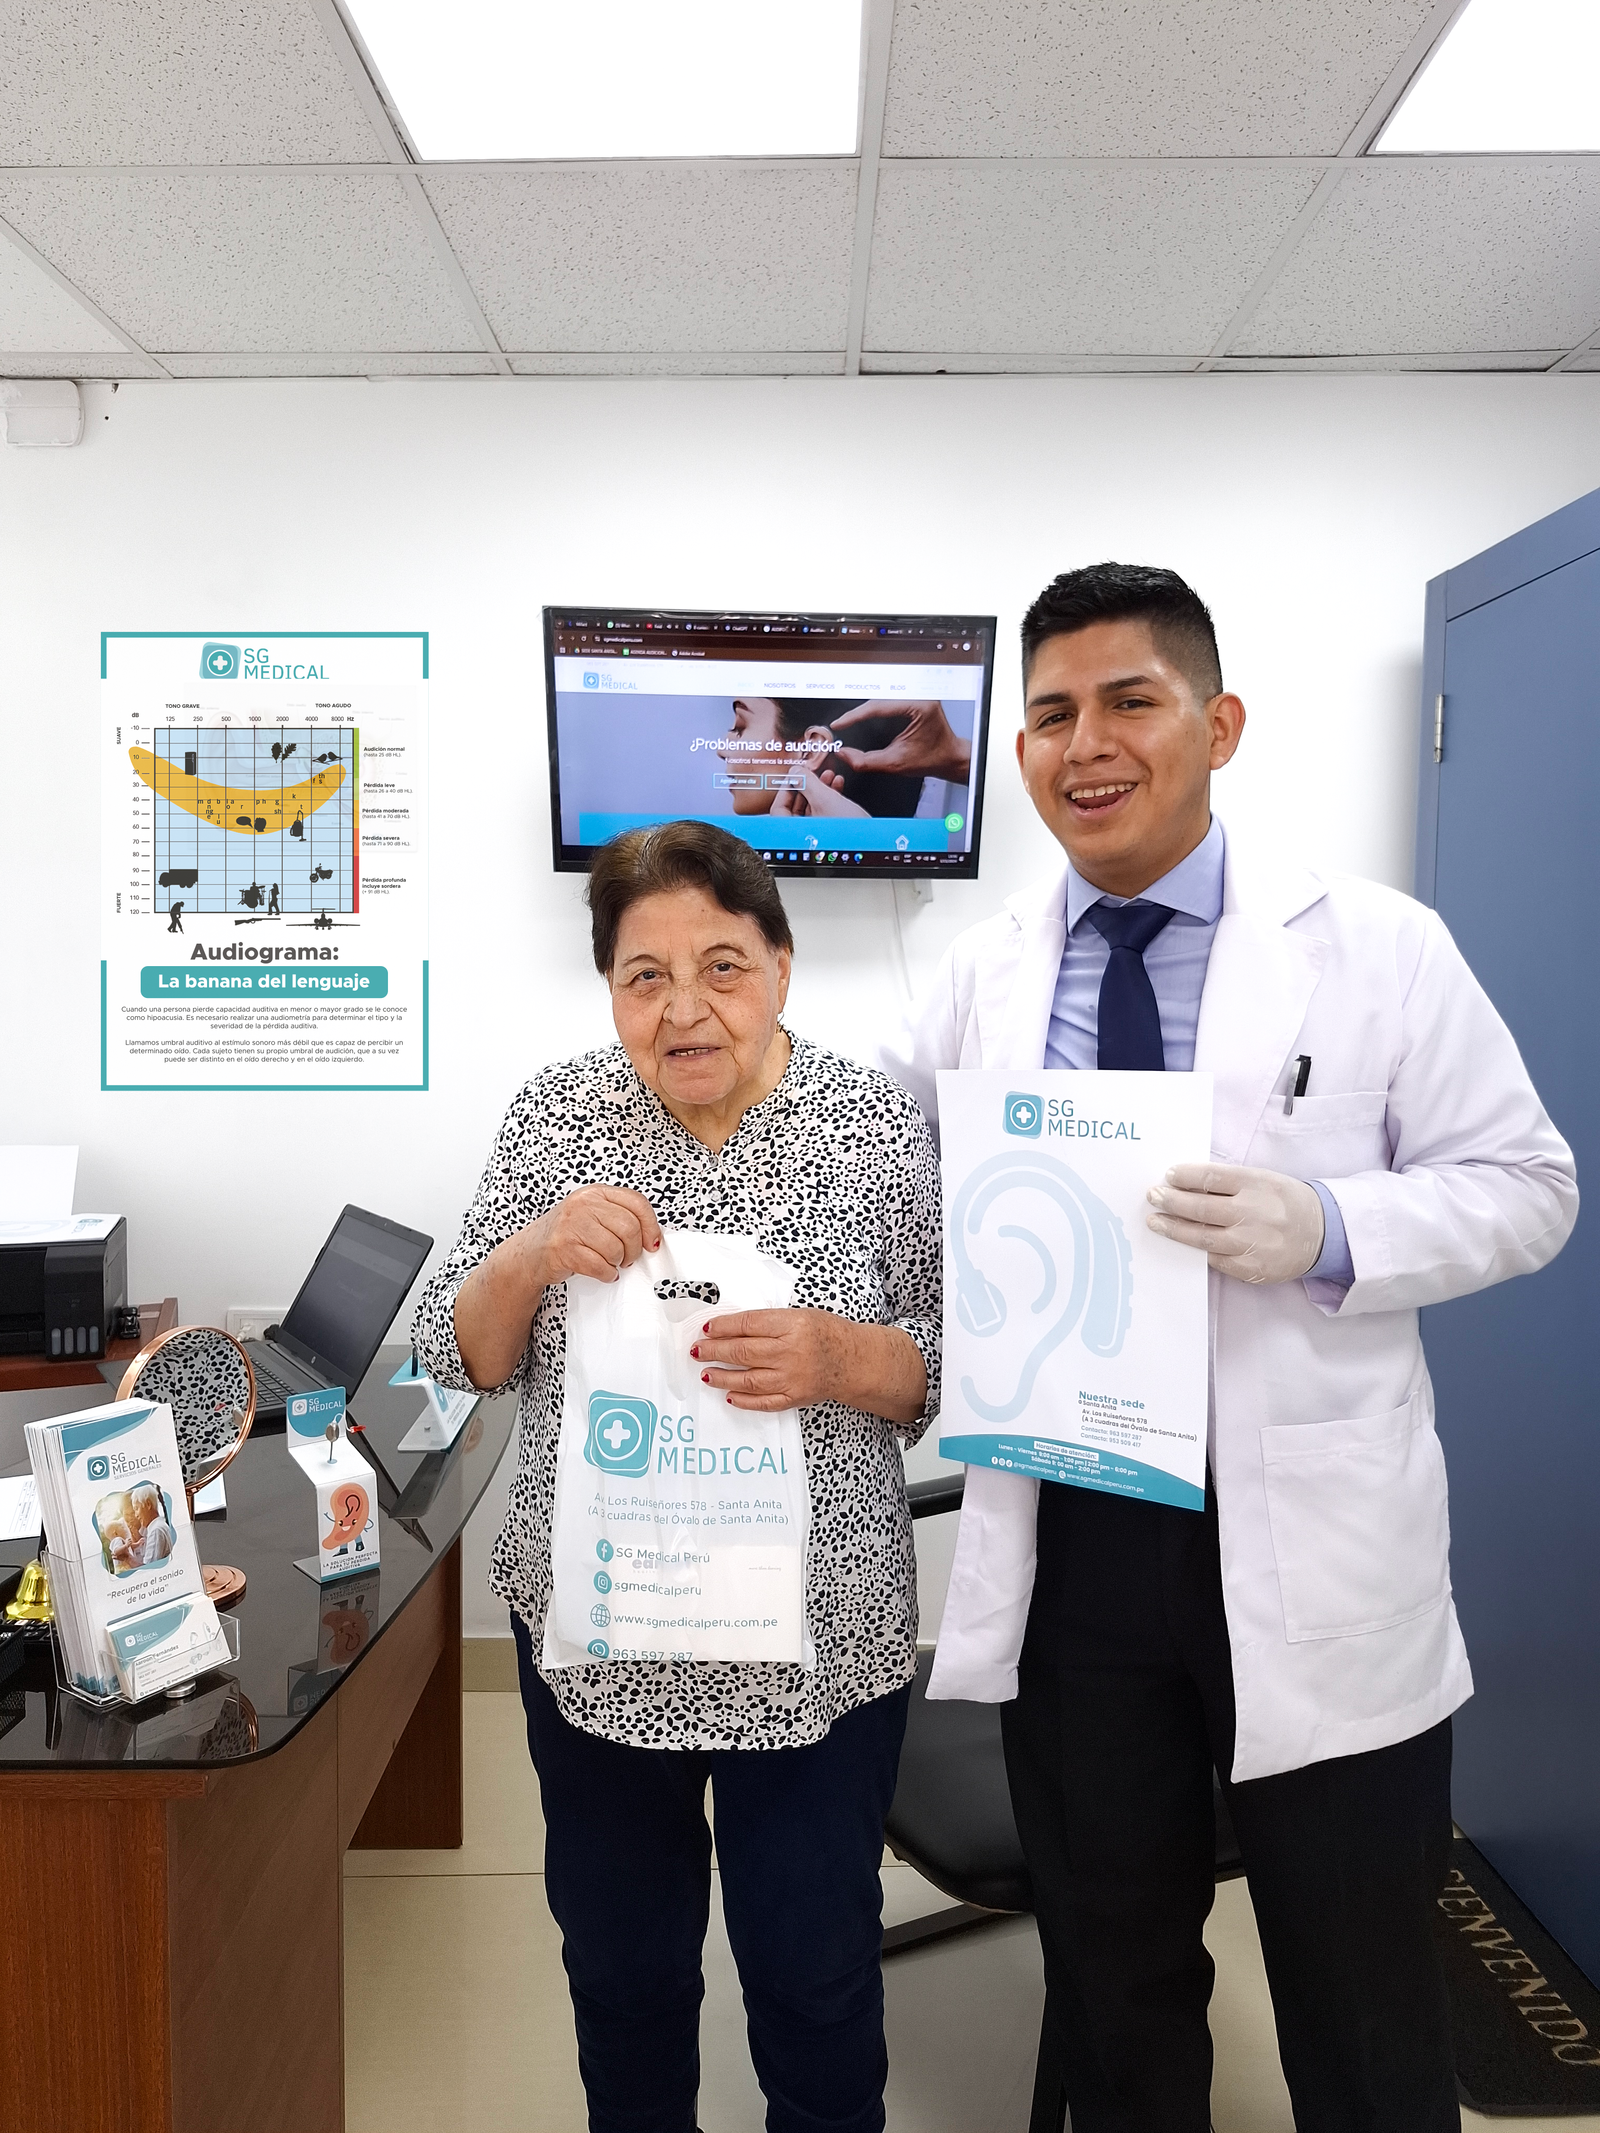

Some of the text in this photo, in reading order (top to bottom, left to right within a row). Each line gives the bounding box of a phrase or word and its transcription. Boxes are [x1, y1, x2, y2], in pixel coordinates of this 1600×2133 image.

[244, 648, 269, 663] SG
[244, 665, 330, 679] MEDICAL
[601, 674, 612, 682] SG
[601, 682, 638, 690] MEDICAL
[690, 738, 843, 753] ¿Problemas de audición?
[190, 942, 339, 964] Audiograma:
[158, 973, 370, 991] La banana del lenguaje
[192, 1006, 214, 1014] pierde
[216, 1006, 250, 1014] capacidad
[343, 1006, 363, 1014] grado
[147, 1014, 184, 1022] hipoacusia.
[375, 1014, 388, 1022] tipo
[1047, 1099, 1074, 1117] SG
[1048, 1119, 1141, 1140] MEDICAL
[309, 1397, 319, 1406] SG
[309, 1401, 343, 1413] MEDICAL
[1078, 1390, 1145, 1409] Nuestra sede
[1083, 1400, 1117, 1411] Santa Anita
[1136, 1417, 1148, 1425] 578
[659, 1415, 695, 1443] SG
[111, 1452, 126, 1465] SG
[112, 1454, 161, 1476] MEDICAL
[657, 1446, 788, 1476] MEDICAL
[608, 1496, 627, 1506] Los
[631, 1496, 687, 1510] Ruiseñores
[690, 1500, 707, 1511] 578
[718, 1500, 750, 1510] Santa
[753, 1499, 782, 1509] Anita
[588, 1505, 789, 1525] (A 3 cuadras del Óvalo de Santa Anita)
[616, 1547, 710, 1563] SG Medical Perú
[150, 1575, 157, 1585] el
[158, 1568, 184, 1583] sonido
[614, 1580, 702, 1597] sgmedicalperu
[126, 1594, 137, 1605] de
[138, 1591, 146, 1600] la
[614, 1614, 778, 1630] www.sgmedicalperu.com.pe
[612, 1648, 693, 1662] 963 597 287
